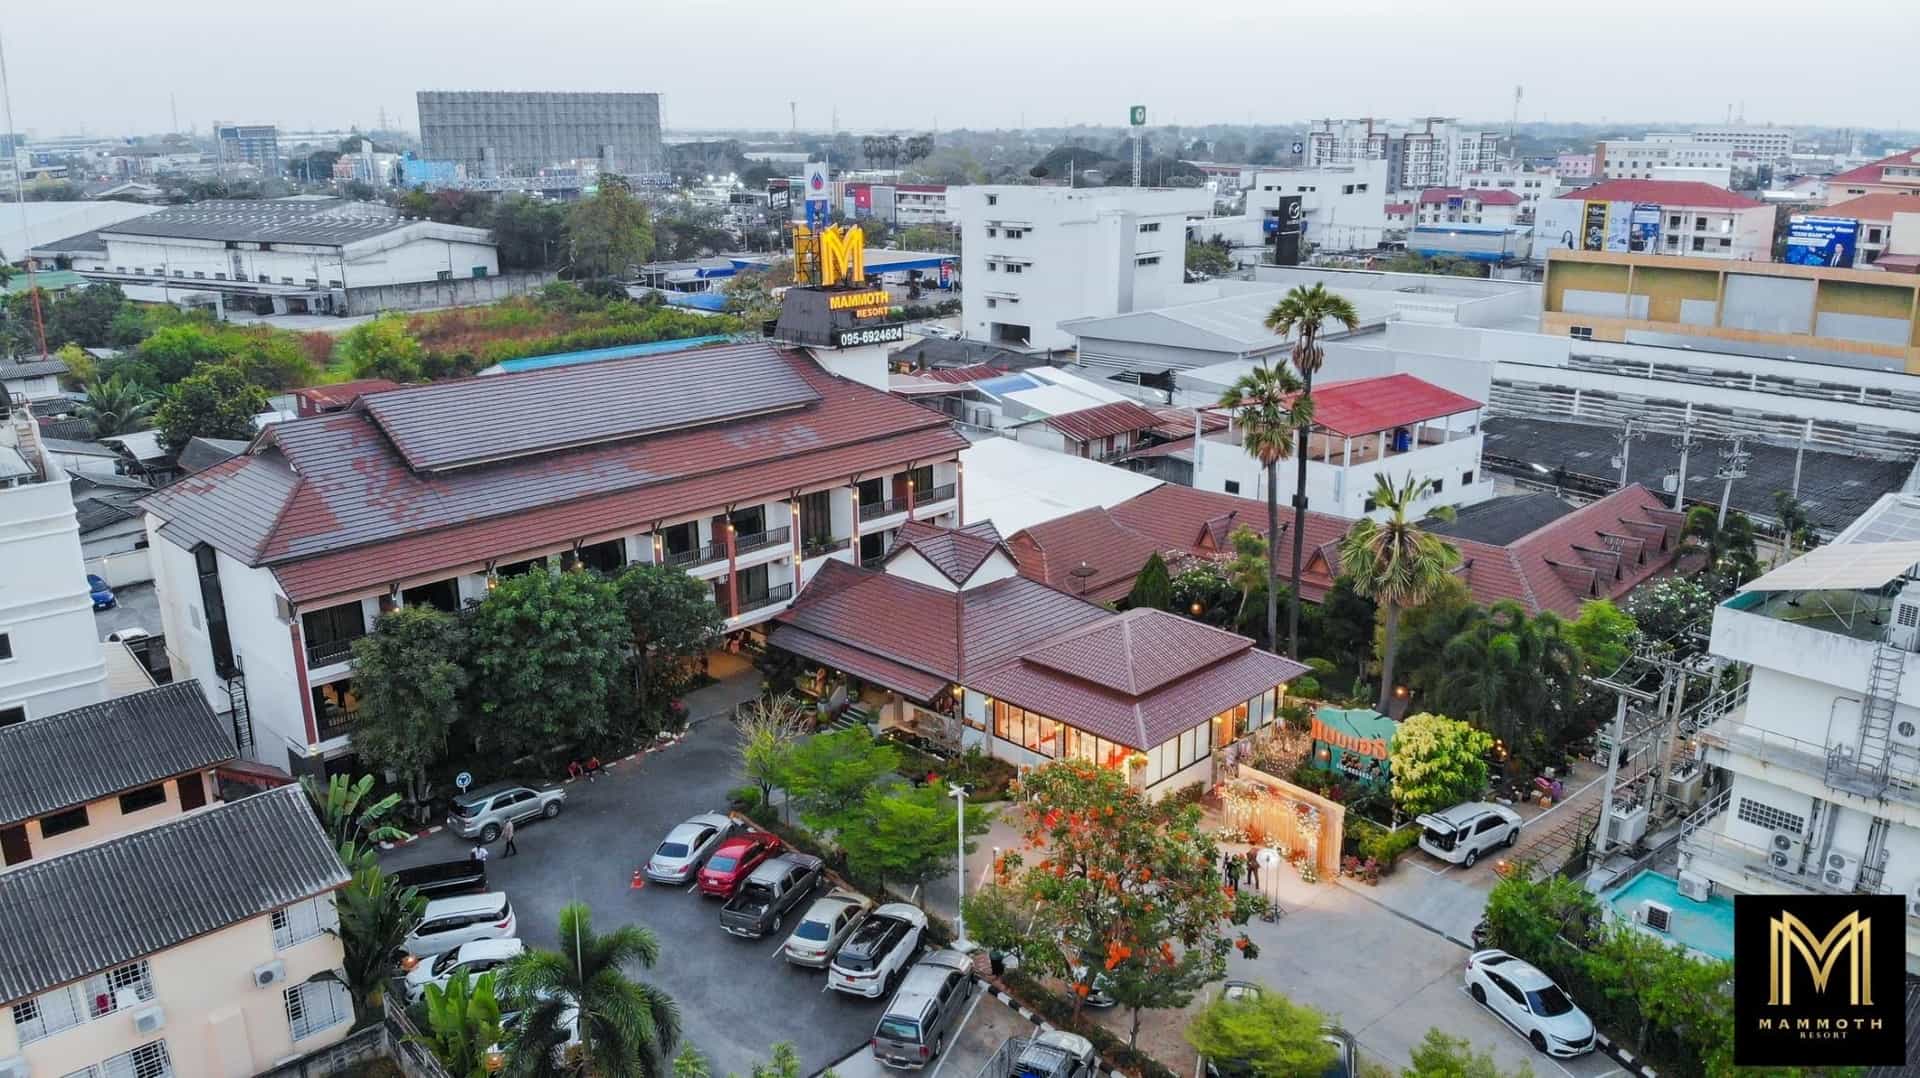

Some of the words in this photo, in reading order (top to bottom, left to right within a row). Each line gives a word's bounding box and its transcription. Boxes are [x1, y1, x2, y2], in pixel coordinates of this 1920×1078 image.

[829, 290, 889, 310] MAMMOTH
[856, 306, 888, 318] RESORT
[841, 327, 902, 346] 095-6924624
